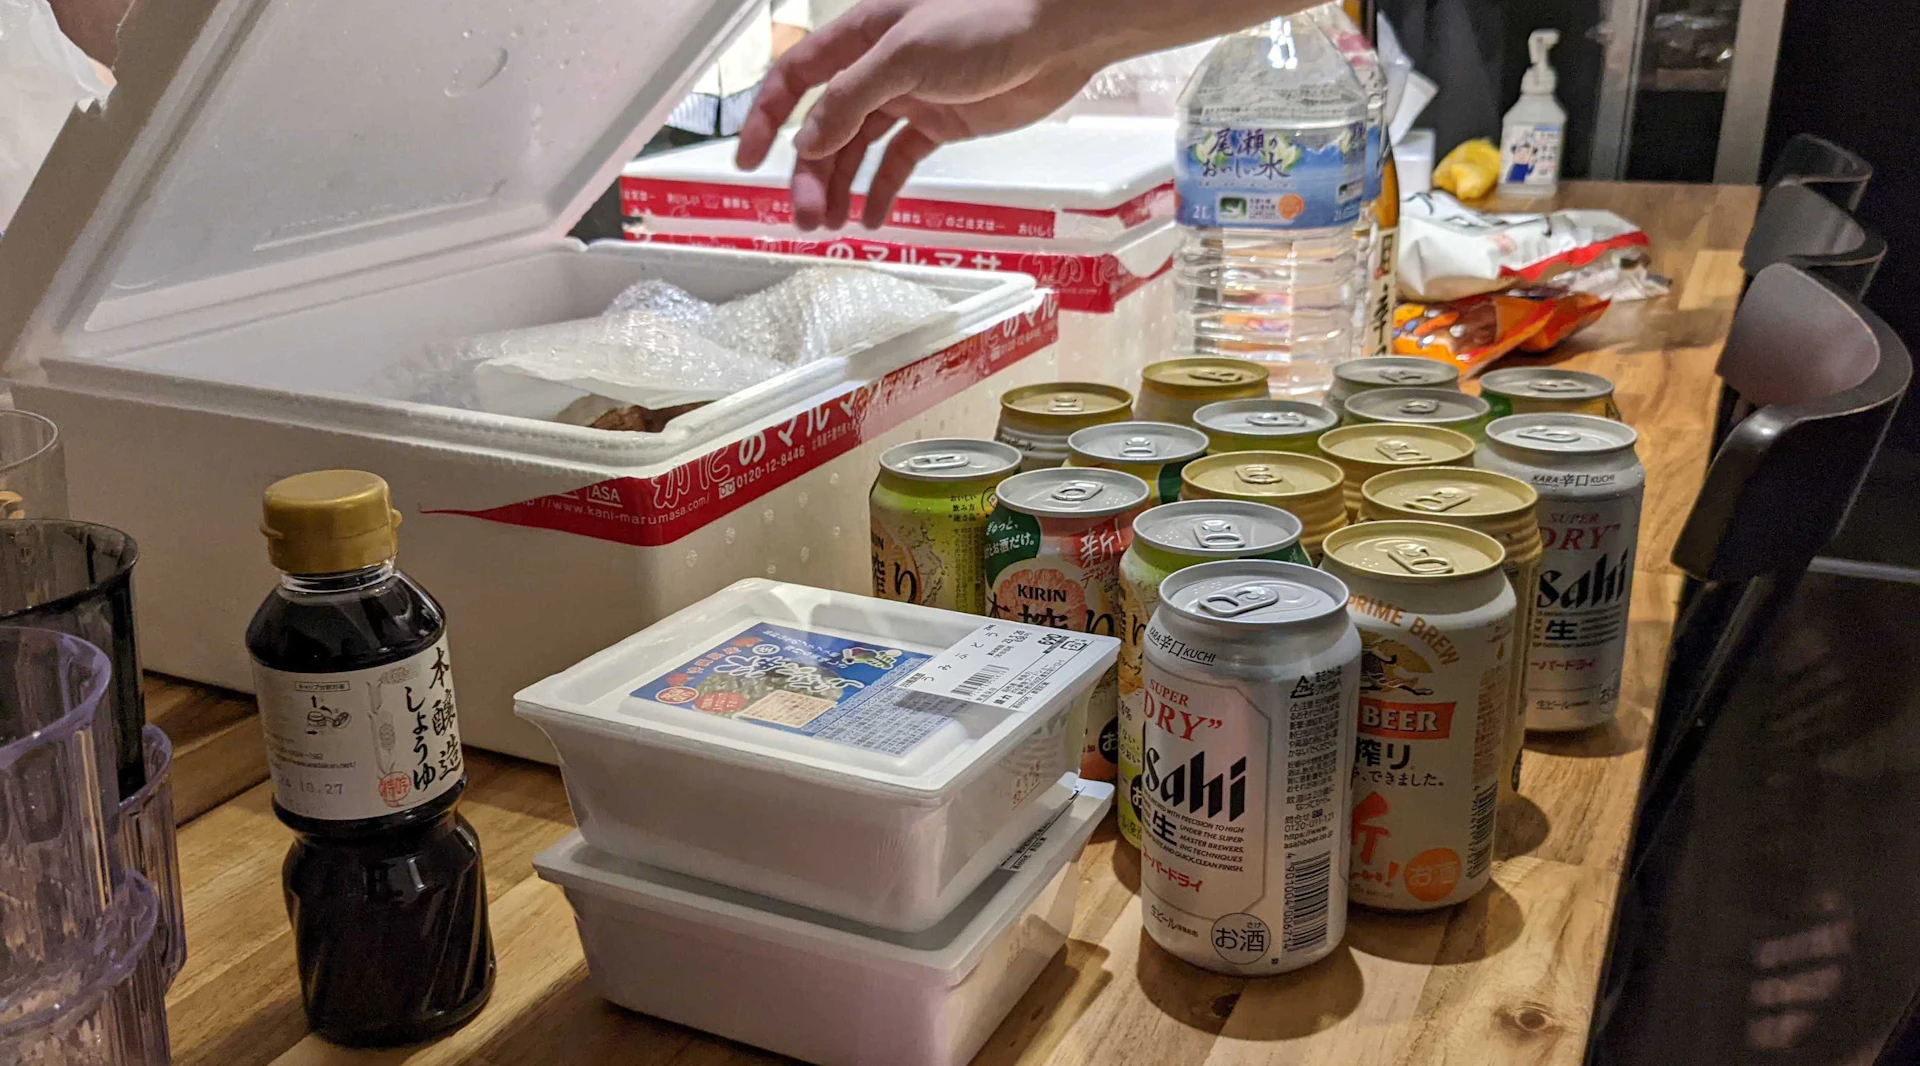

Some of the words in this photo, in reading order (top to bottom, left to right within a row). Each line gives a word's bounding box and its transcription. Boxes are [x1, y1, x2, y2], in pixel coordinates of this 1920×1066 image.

[1203, 151, 1292, 181] おいしい水
[736, 445, 805, 488] 0120-12-8446
[1559, 473, 1589, 487] 辛口
[1550, 512, 1600, 524] SUPER
[1017, 584, 1067, 603] KIRIN
[1409, 616, 1460, 665] BREW
[1545, 620, 1578, 640] 生
[1159, 635, 1185, 657] 辛口
[1183, 647, 1216, 664] KUCHI
[1150, 678, 1189, 708] SUPER
[429, 646, 464, 781] 本醸造
[1361, 704, 1438, 734] BEER
[404, 686, 437, 792] しょうゆ
[1153, 810, 1178, 847] 生
[1180, 824, 1202, 836] UNDER
[1203, 830, 1219, 840] THE
[1181, 815, 1214, 829] PRECISION
[1215, 824, 1225, 832] TO
[1225, 825, 1245, 834] HIGH
[1180, 834, 1207, 847] MASTER
[1180, 844, 1192, 852] ING
[1193, 847, 1243, 863] TECHNIQUES
[1195, 858, 1218, 869] CLEAN
[1214, 928, 1266, 953] お酒
